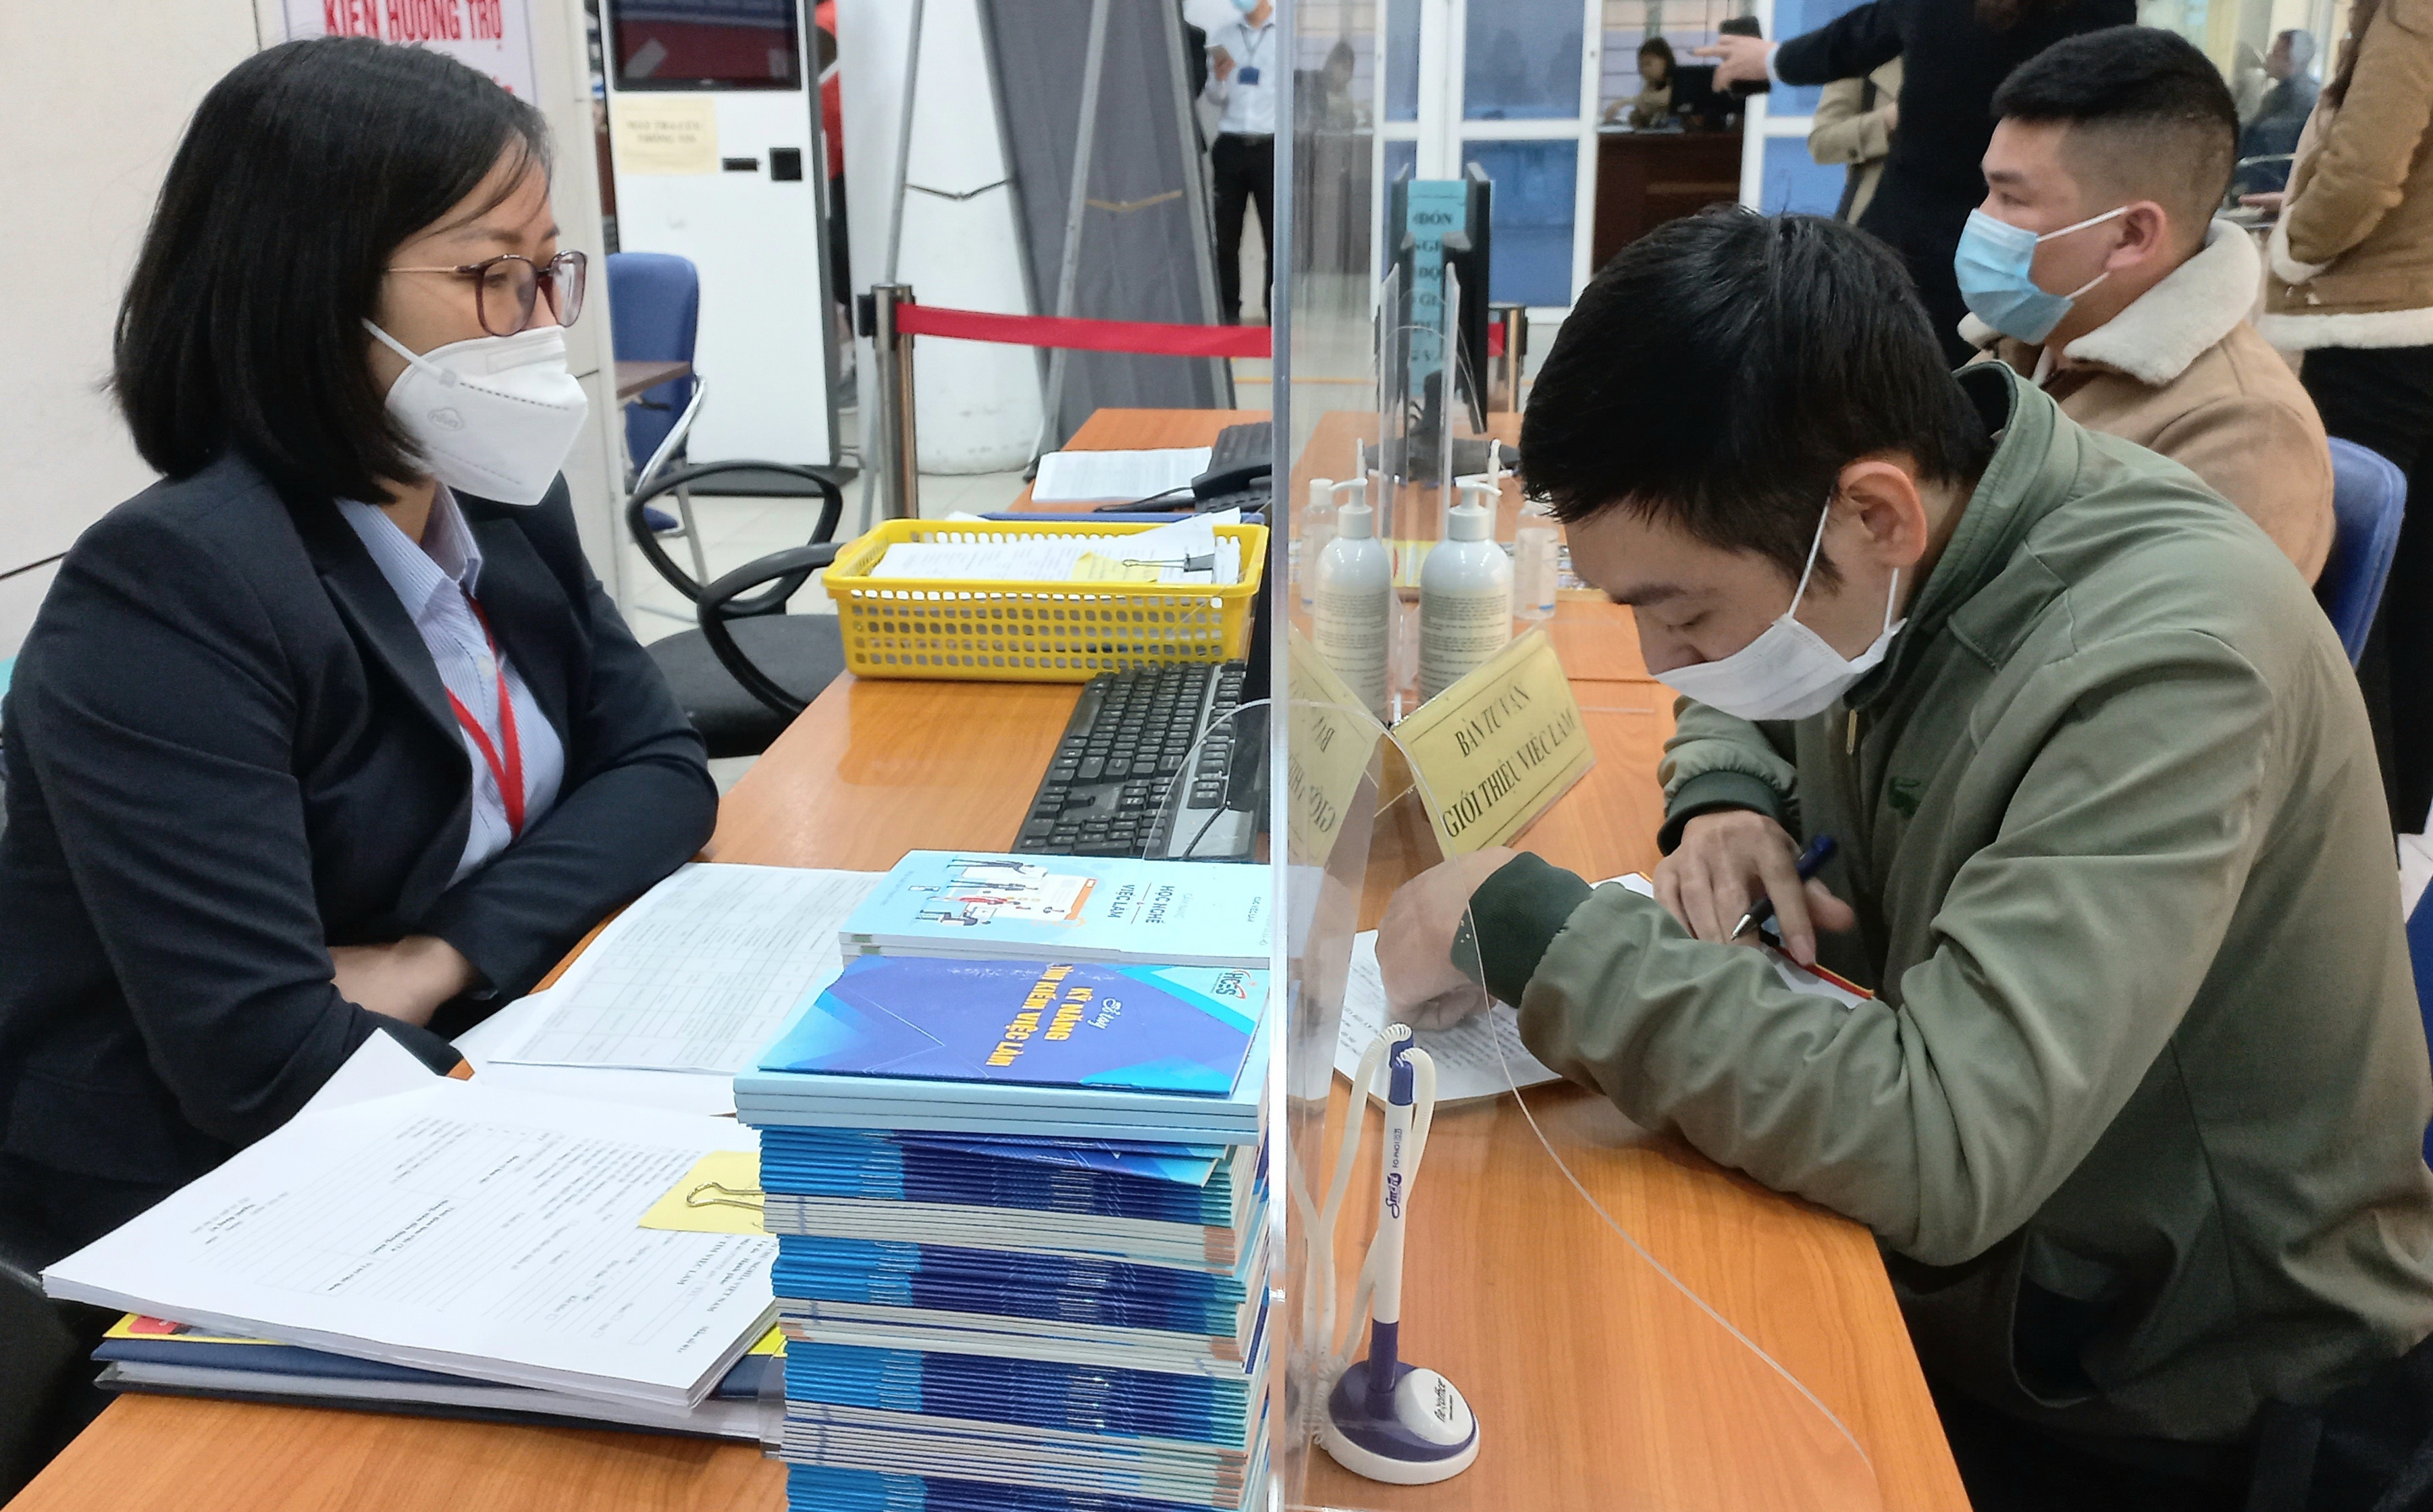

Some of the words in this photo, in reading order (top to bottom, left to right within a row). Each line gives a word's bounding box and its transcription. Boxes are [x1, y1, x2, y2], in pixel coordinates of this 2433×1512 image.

[1442, 789, 1484, 837] GIỚI
[1478, 758, 1521, 808] THIỆU
[1516, 731, 1551, 771] VIỆC
[1115, 884, 1135, 902] VIỆC
[1155, 885, 1176, 902] HỌC
[1107, 902, 1130, 918] LÀM
[1041, 964, 1074, 981] TÌM
[1021, 981, 1060, 1010] KIẾM
[1004, 1011, 1042, 1041] VIỆC
[1044, 1002, 1084, 1041] NĂNG
[985, 1041, 1024, 1067] LÀM
